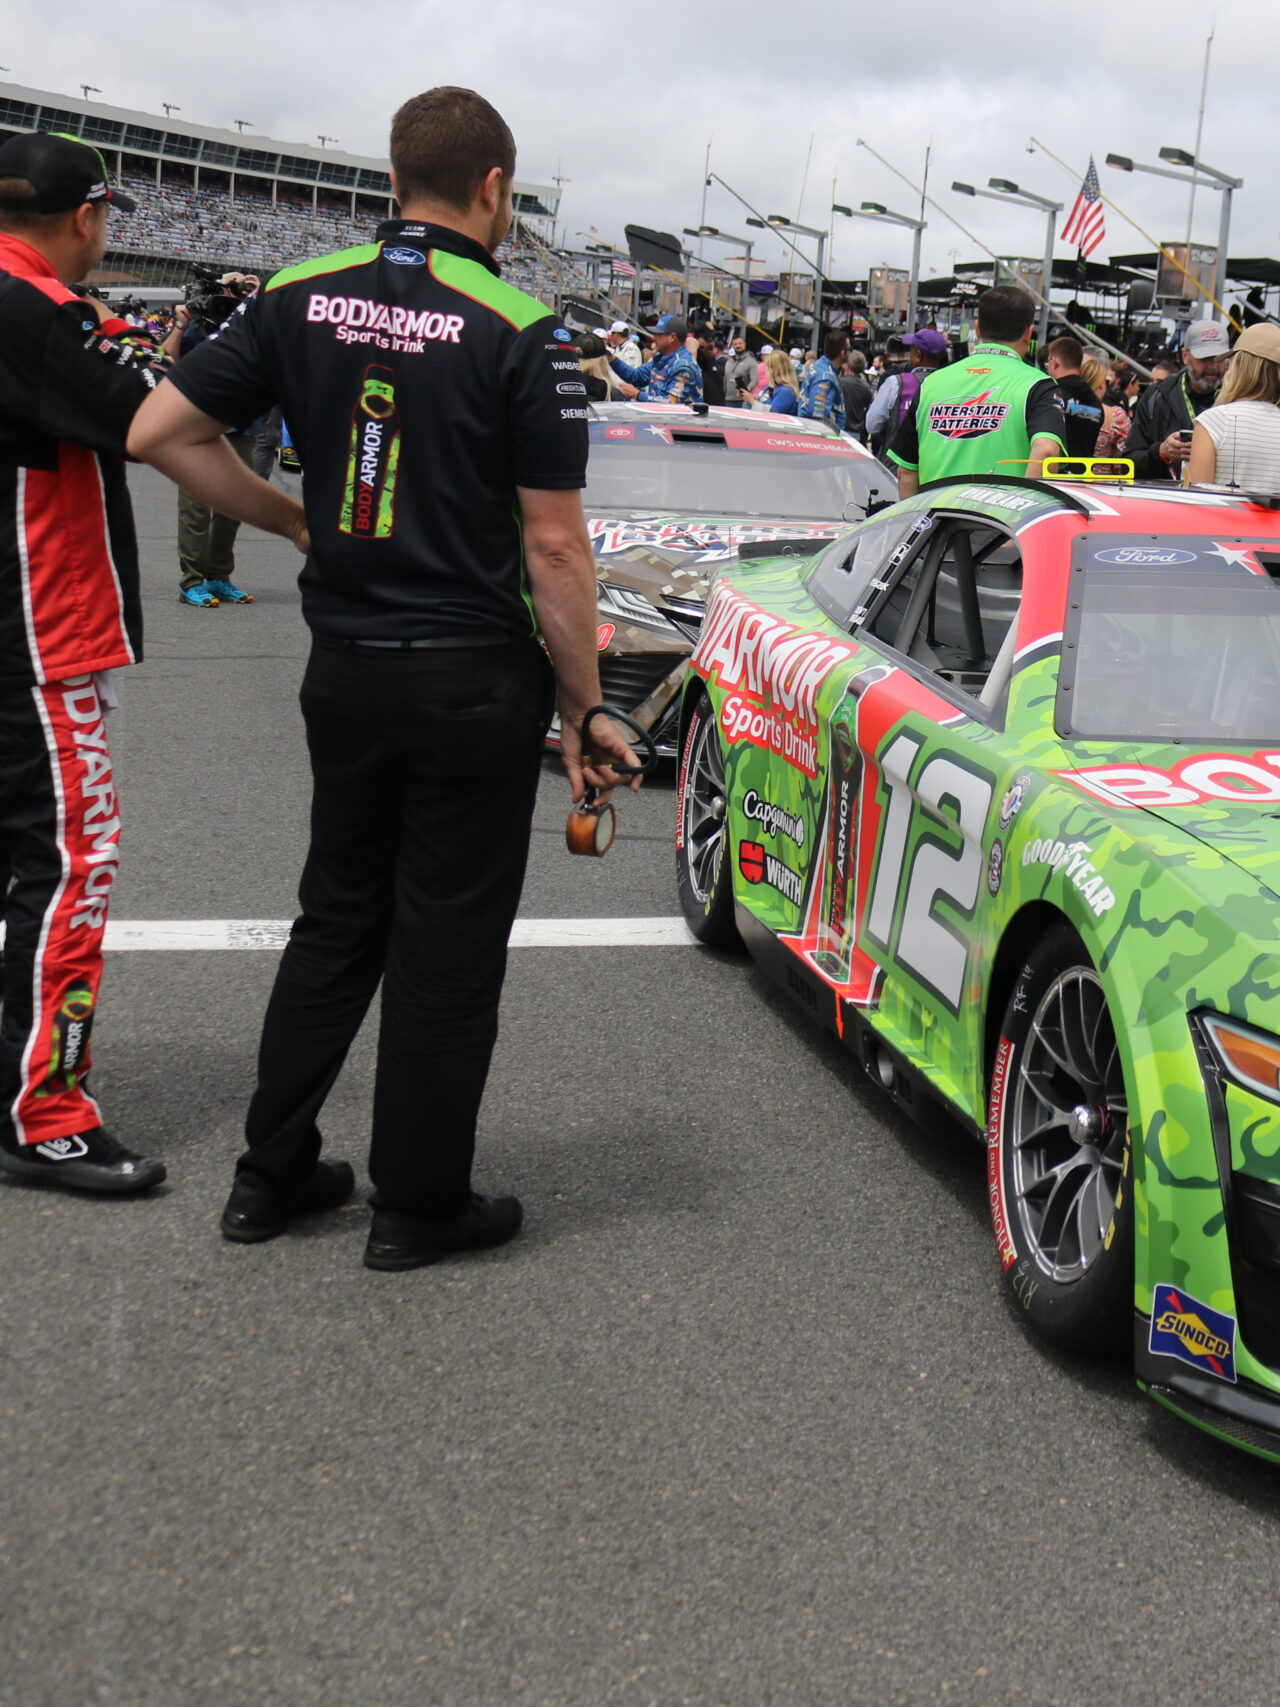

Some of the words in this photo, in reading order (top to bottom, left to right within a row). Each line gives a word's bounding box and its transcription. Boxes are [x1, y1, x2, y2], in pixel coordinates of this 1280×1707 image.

[307, 294, 465, 343] BODYARMOR
[336, 325, 390, 348] Sports
[552, 362, 581, 371] WABAS
[930, 404, 1007, 418] INTERSTATE
[931, 418, 1000, 431] BATTERIES
[356, 420, 383, 531] BODYARMOR
[1114, 549, 1178, 564] Ford
[722, 697, 782, 749] Sports
[784, 721, 817, 773] Drink
[744, 791, 799, 840] Capgemini
[766, 856, 801, 905] WÜRTH
[866, 733, 992, 1012] 12
[987, 1042, 1009, 1151] REMEMBER
[989, 1152, 998, 1178] AND
[989, 1178, 1011, 1249] HONOR
[1161, 1314, 1230, 1358] SUNOCO
